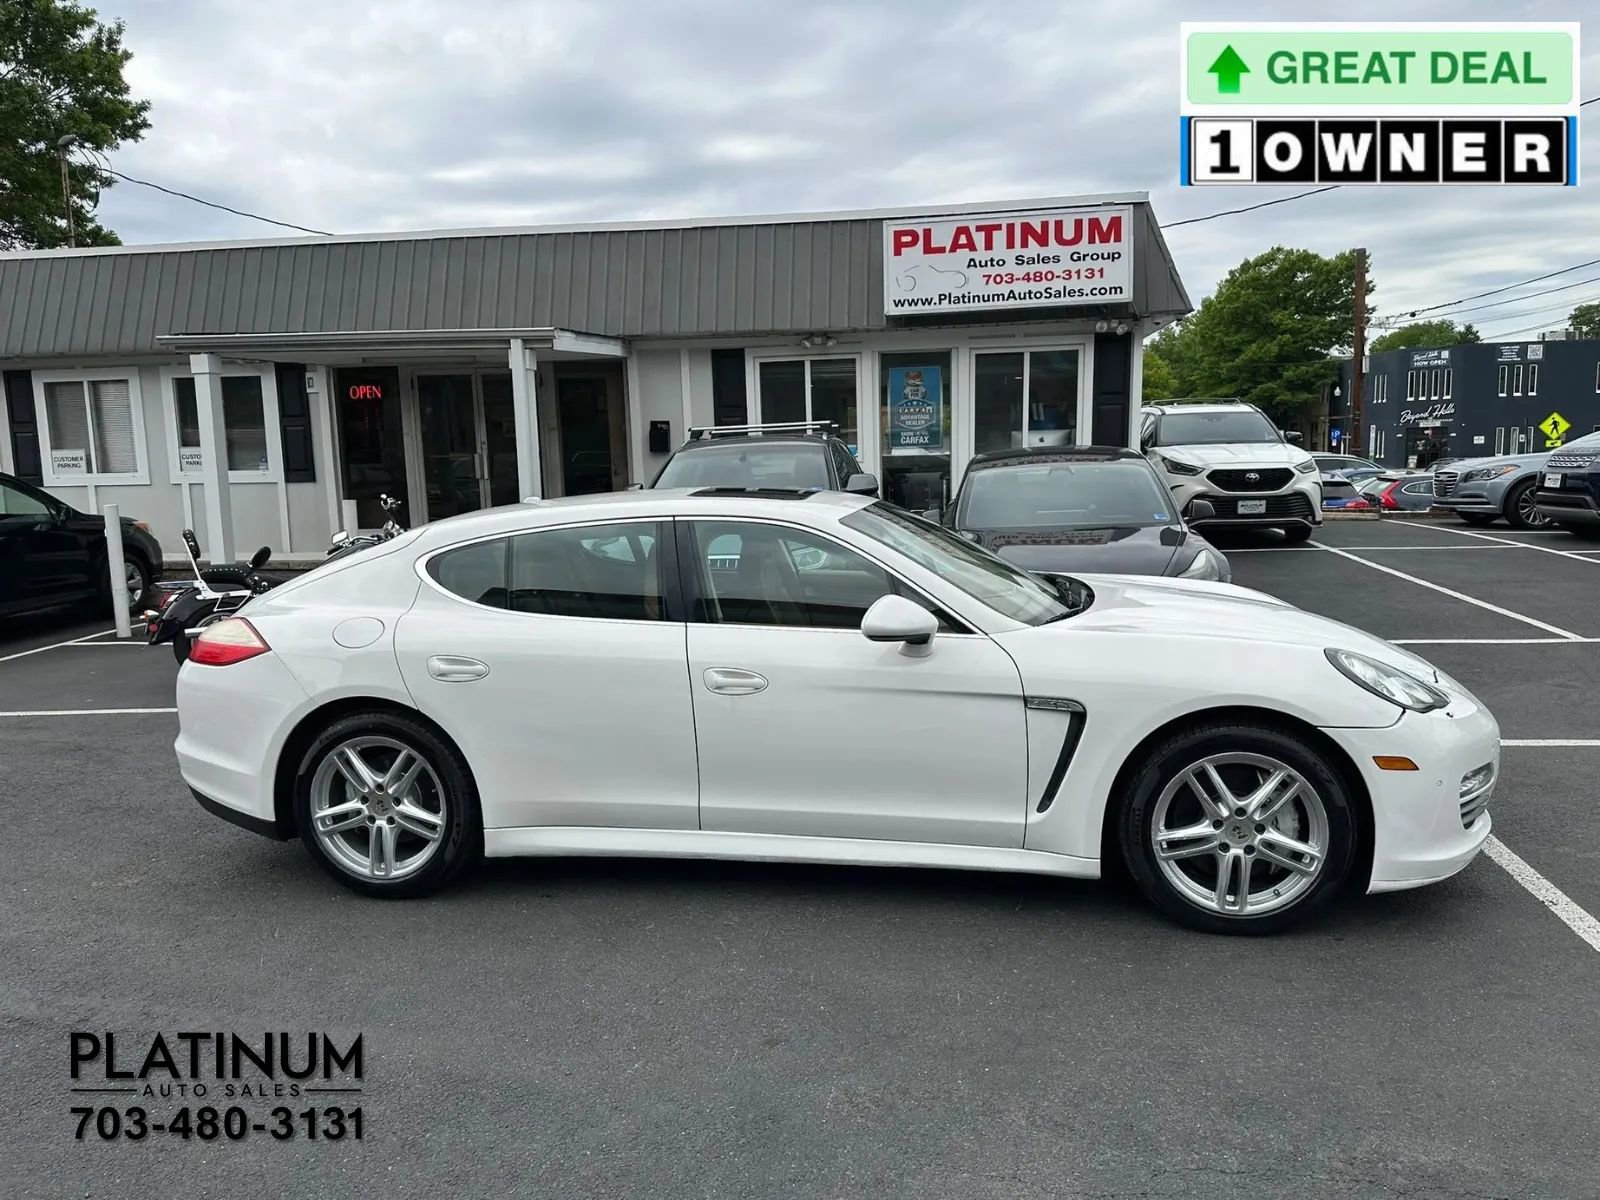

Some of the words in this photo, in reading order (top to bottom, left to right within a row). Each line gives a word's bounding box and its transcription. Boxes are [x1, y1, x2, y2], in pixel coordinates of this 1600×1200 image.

[893, 215, 1122, 257] PLATINUM
[966, 257, 1006, 269] Auto
[1014, 254, 1061, 267] Sales
[1069, 251, 1122, 264] Group
[982, 267, 1105, 286] 703-480-3131
[893, 284, 1124, 308] www.PlatinumAutoSales.com
[349, 385, 382, 400] OPEN
[900, 436, 929, 444] CARFAX
